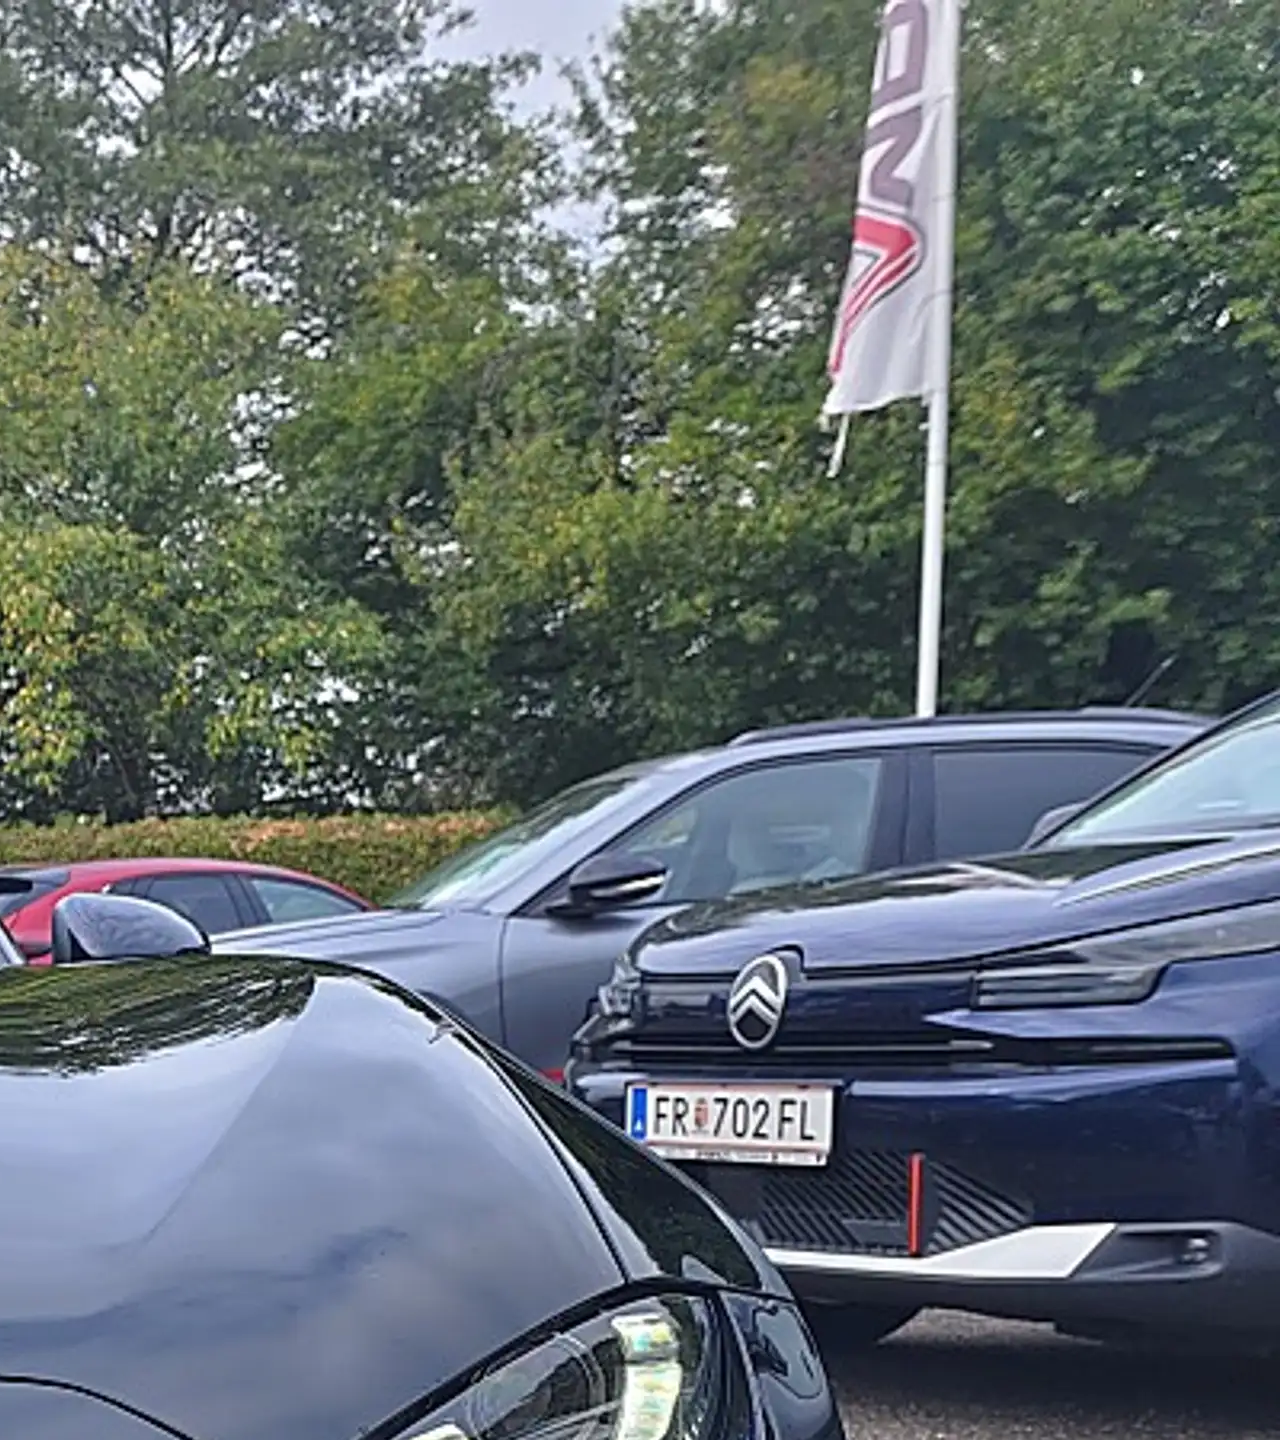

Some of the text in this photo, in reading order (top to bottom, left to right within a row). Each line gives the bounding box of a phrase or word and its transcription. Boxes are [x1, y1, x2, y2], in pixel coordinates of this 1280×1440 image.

[653, 1096, 815, 1141] FR 702 FL
